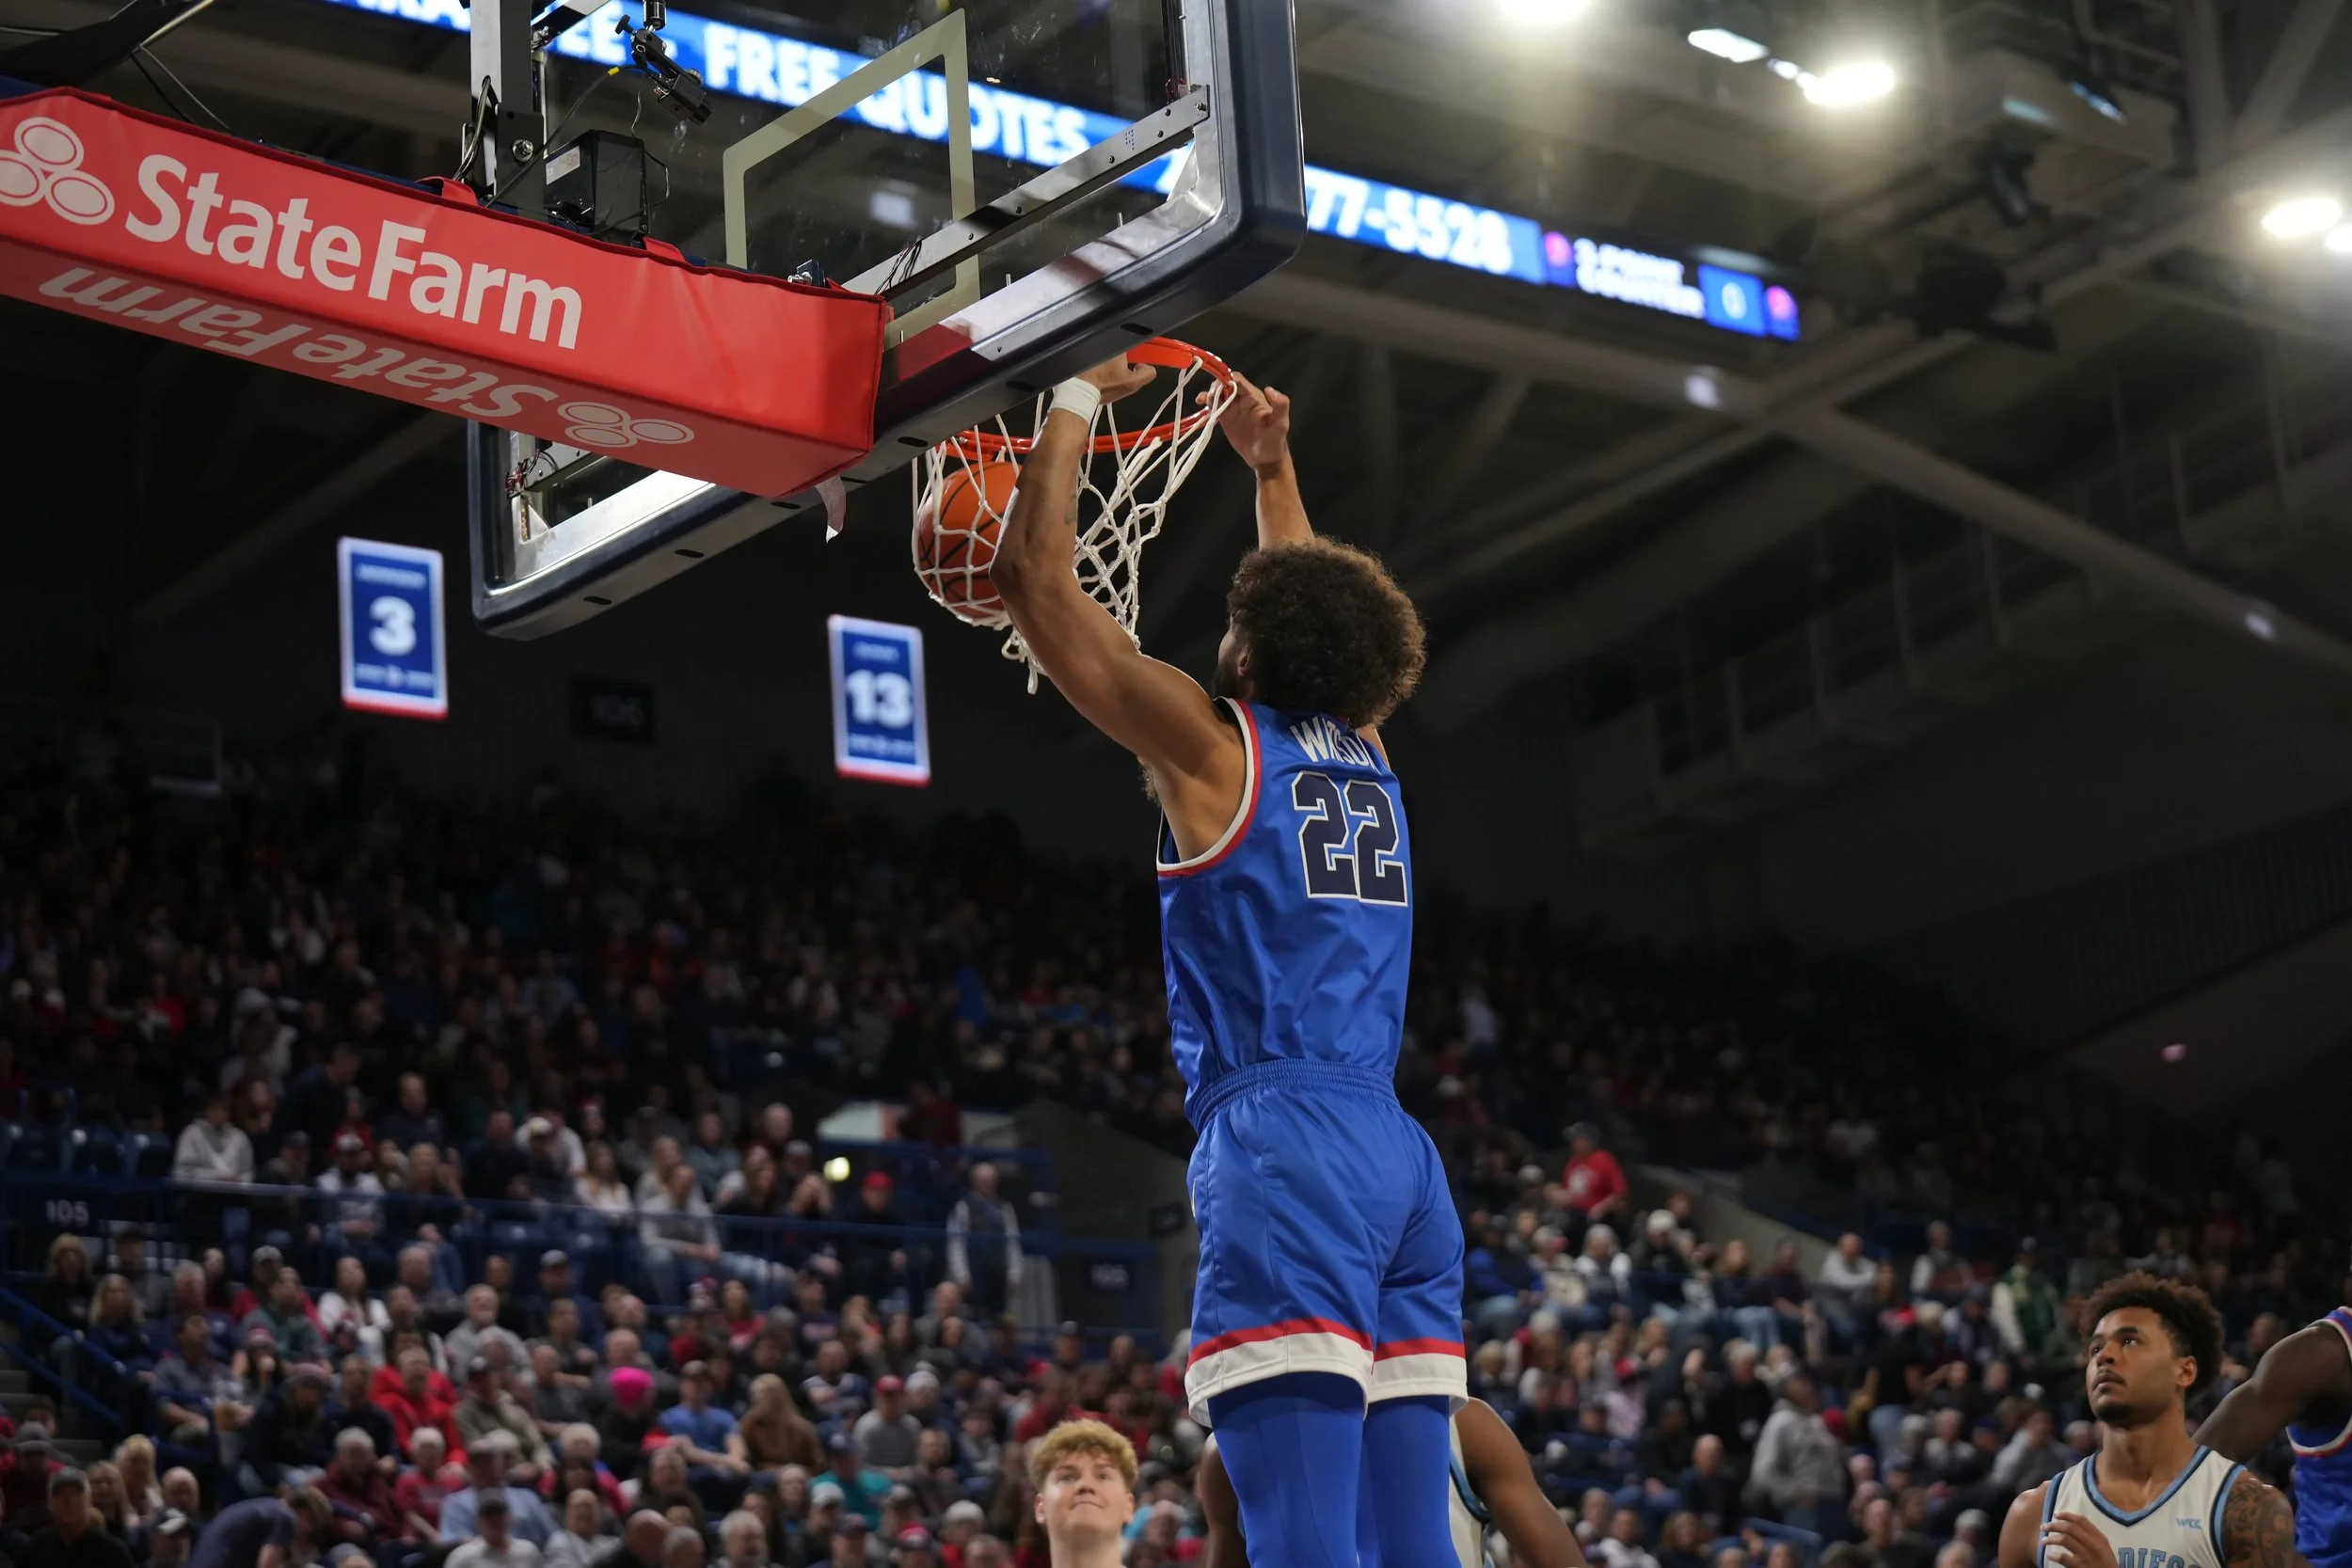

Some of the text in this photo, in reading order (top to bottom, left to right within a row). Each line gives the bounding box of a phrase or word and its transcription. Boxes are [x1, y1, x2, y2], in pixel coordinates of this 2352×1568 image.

[704, 22, 845, 107] FREE
[852, 60, 1092, 167] QUOTES
[369, 595, 417, 657] 3
[845, 669, 914, 729] 13
[1291, 770, 1408, 907] 22
[45, 1198, 89, 1227] 105
